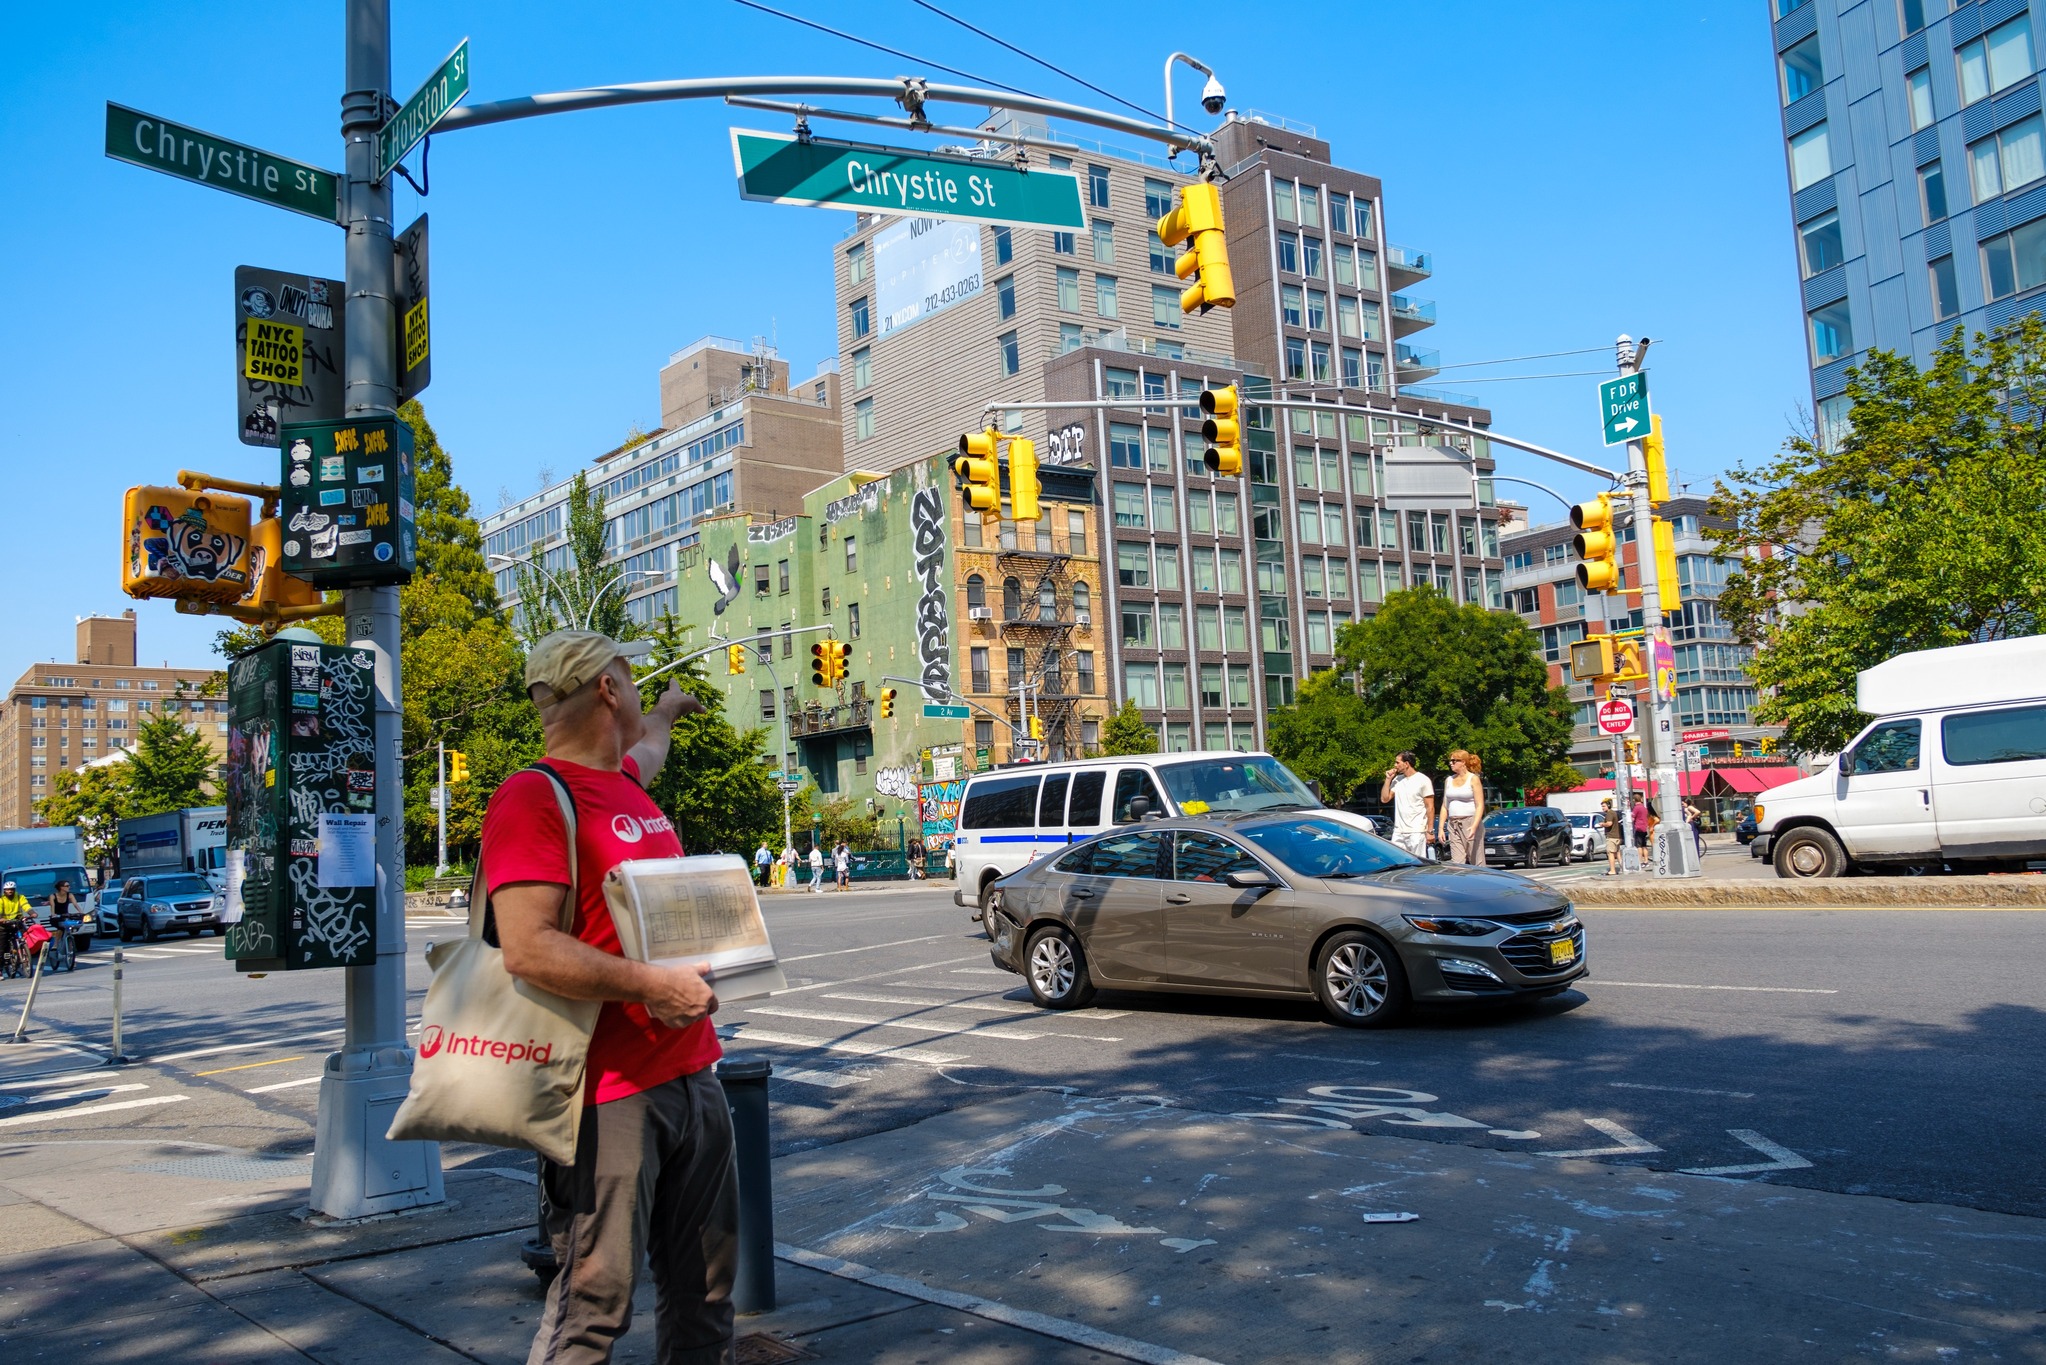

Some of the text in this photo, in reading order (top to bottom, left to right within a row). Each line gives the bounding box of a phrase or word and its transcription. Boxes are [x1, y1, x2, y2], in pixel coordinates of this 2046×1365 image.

[380, 50, 465, 171] E Houston St
[135, 120, 318, 195] Chrystie St
[847, 160, 996, 207] Chrystie St
[881, 234, 970, 292] JUPITER 21
[925, 273, 981, 313] 212-433-0263
[409, 306, 423, 325] NYC
[257, 324, 294, 344] NYC
[407, 322, 426, 349] TATTOO
[251, 339, 299, 364] TATTOO
[408, 340, 427, 366] SHOP
[250, 359, 299, 380] SHOP
[1611, 400, 1639, 416] Drive
[940, 708, 953, 716] 2 Av
[343, 819, 367, 827] Repair
[638, 815, 674, 834] Intre
[446, 1032, 553, 1065] Intrepid
